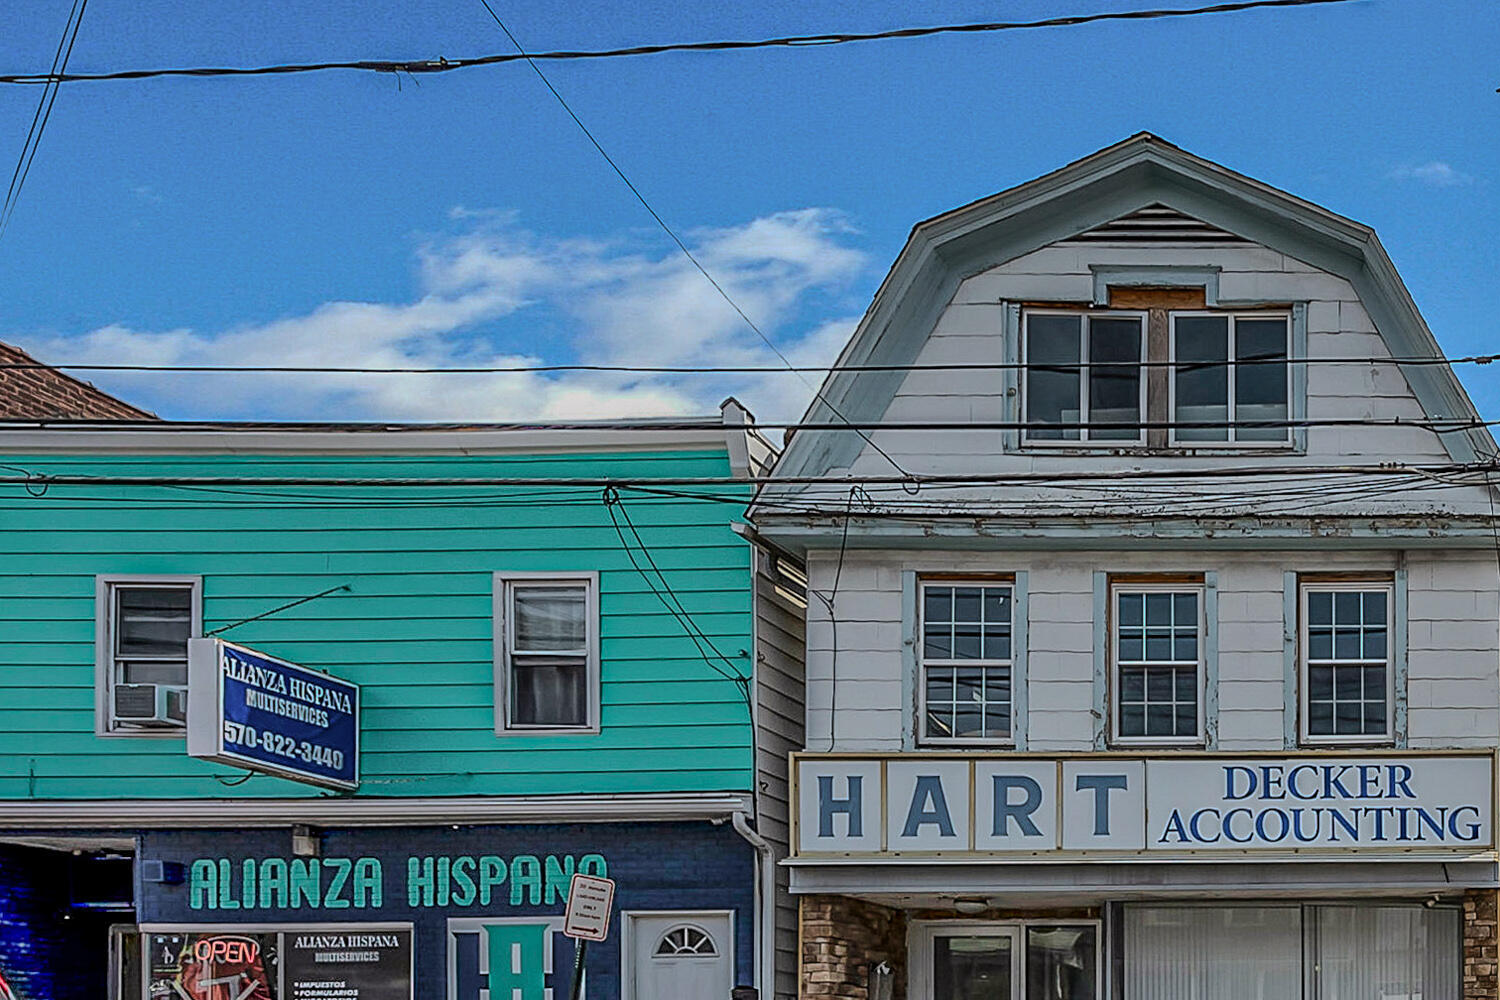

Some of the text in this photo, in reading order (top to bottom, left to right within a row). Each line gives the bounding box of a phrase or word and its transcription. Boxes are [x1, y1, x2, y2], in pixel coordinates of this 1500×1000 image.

[223, 656, 352, 714] ALIANZA HISPANA
[246, 688, 329, 728] MULTISERVICES
[224, 720, 344, 771] 570-822-3440
[1222, 764, 1416, 800] DECKER
[817, 775, 1128, 838] HART
[1158, 805, 1482, 843] ACCOUNTING
[190, 857, 382, 909] ALIANZA
[195, 940, 256, 964] OPEN
[294, 935, 399, 948] ALIANZA HISPANA
[315, 952, 380, 962] MULTISERVICES
[300, 989, 359, 997] FORMULARIOS
